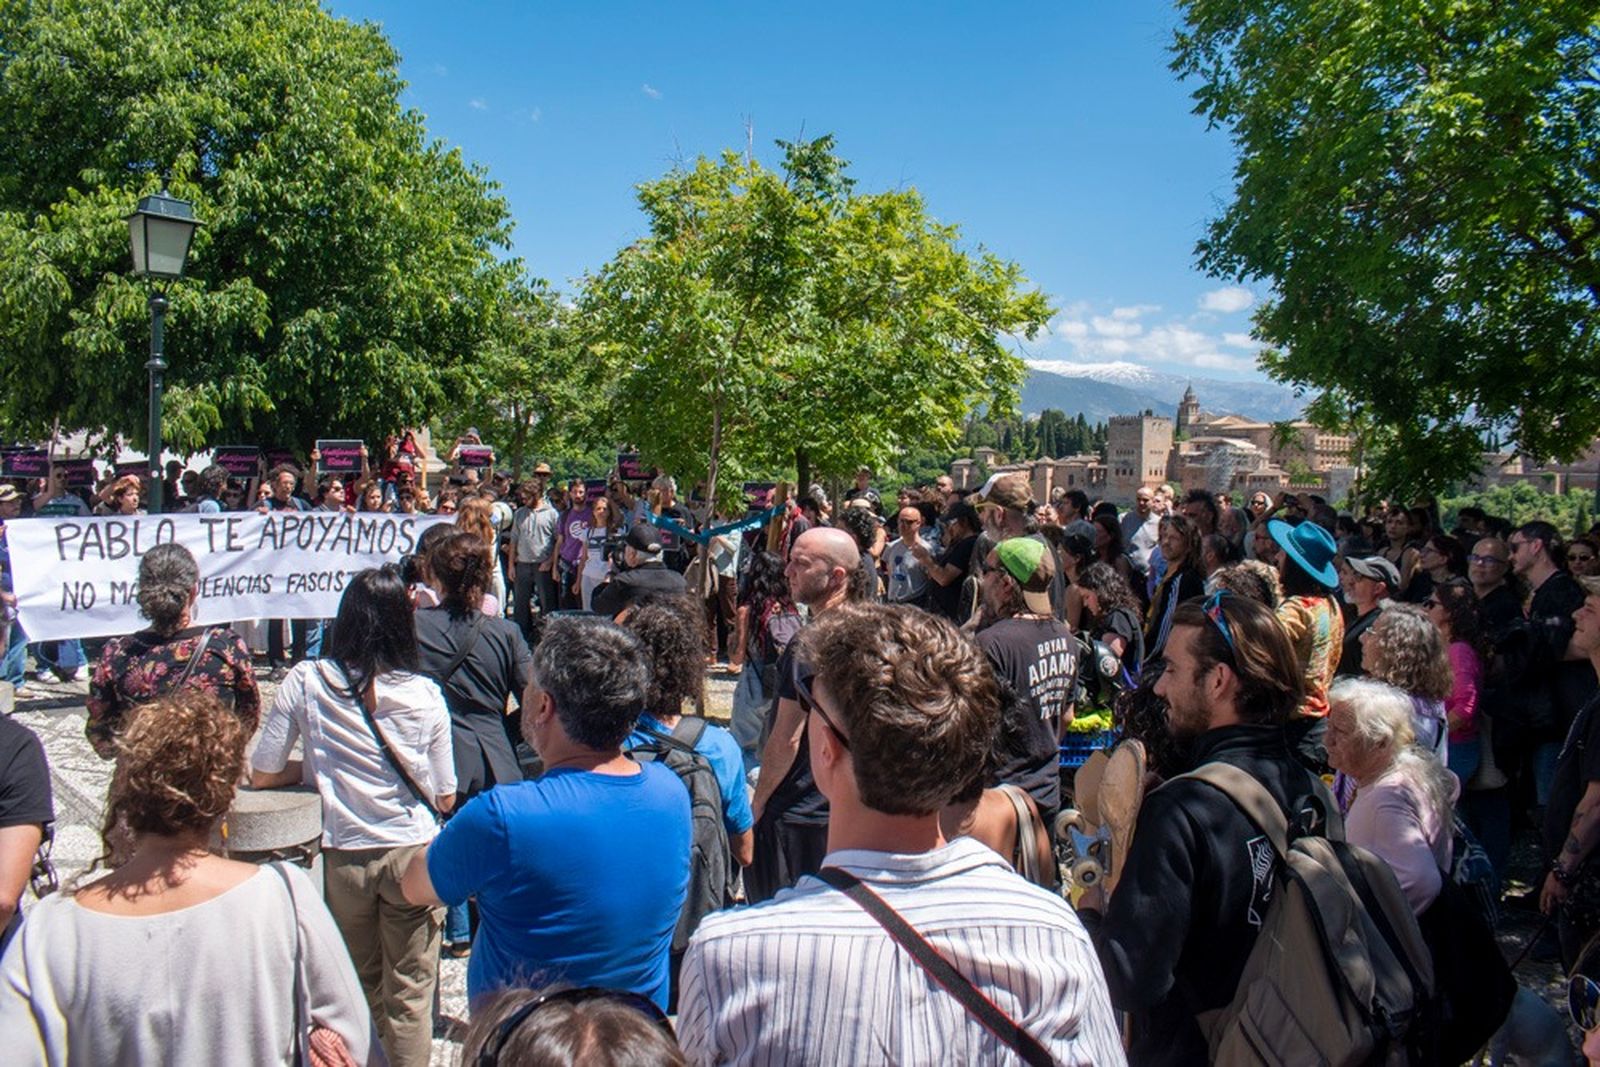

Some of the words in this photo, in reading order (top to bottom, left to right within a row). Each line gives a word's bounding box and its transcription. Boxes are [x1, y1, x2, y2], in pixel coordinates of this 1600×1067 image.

[55, 518, 175, 561] PABLO
[200, 518, 244, 553] TE
[259, 513, 415, 555] APOYAMOS
[61, 580, 96, 611] NO
[1038, 638, 1067, 657] BRYAN
[1029, 653, 1076, 686] ADAMS
